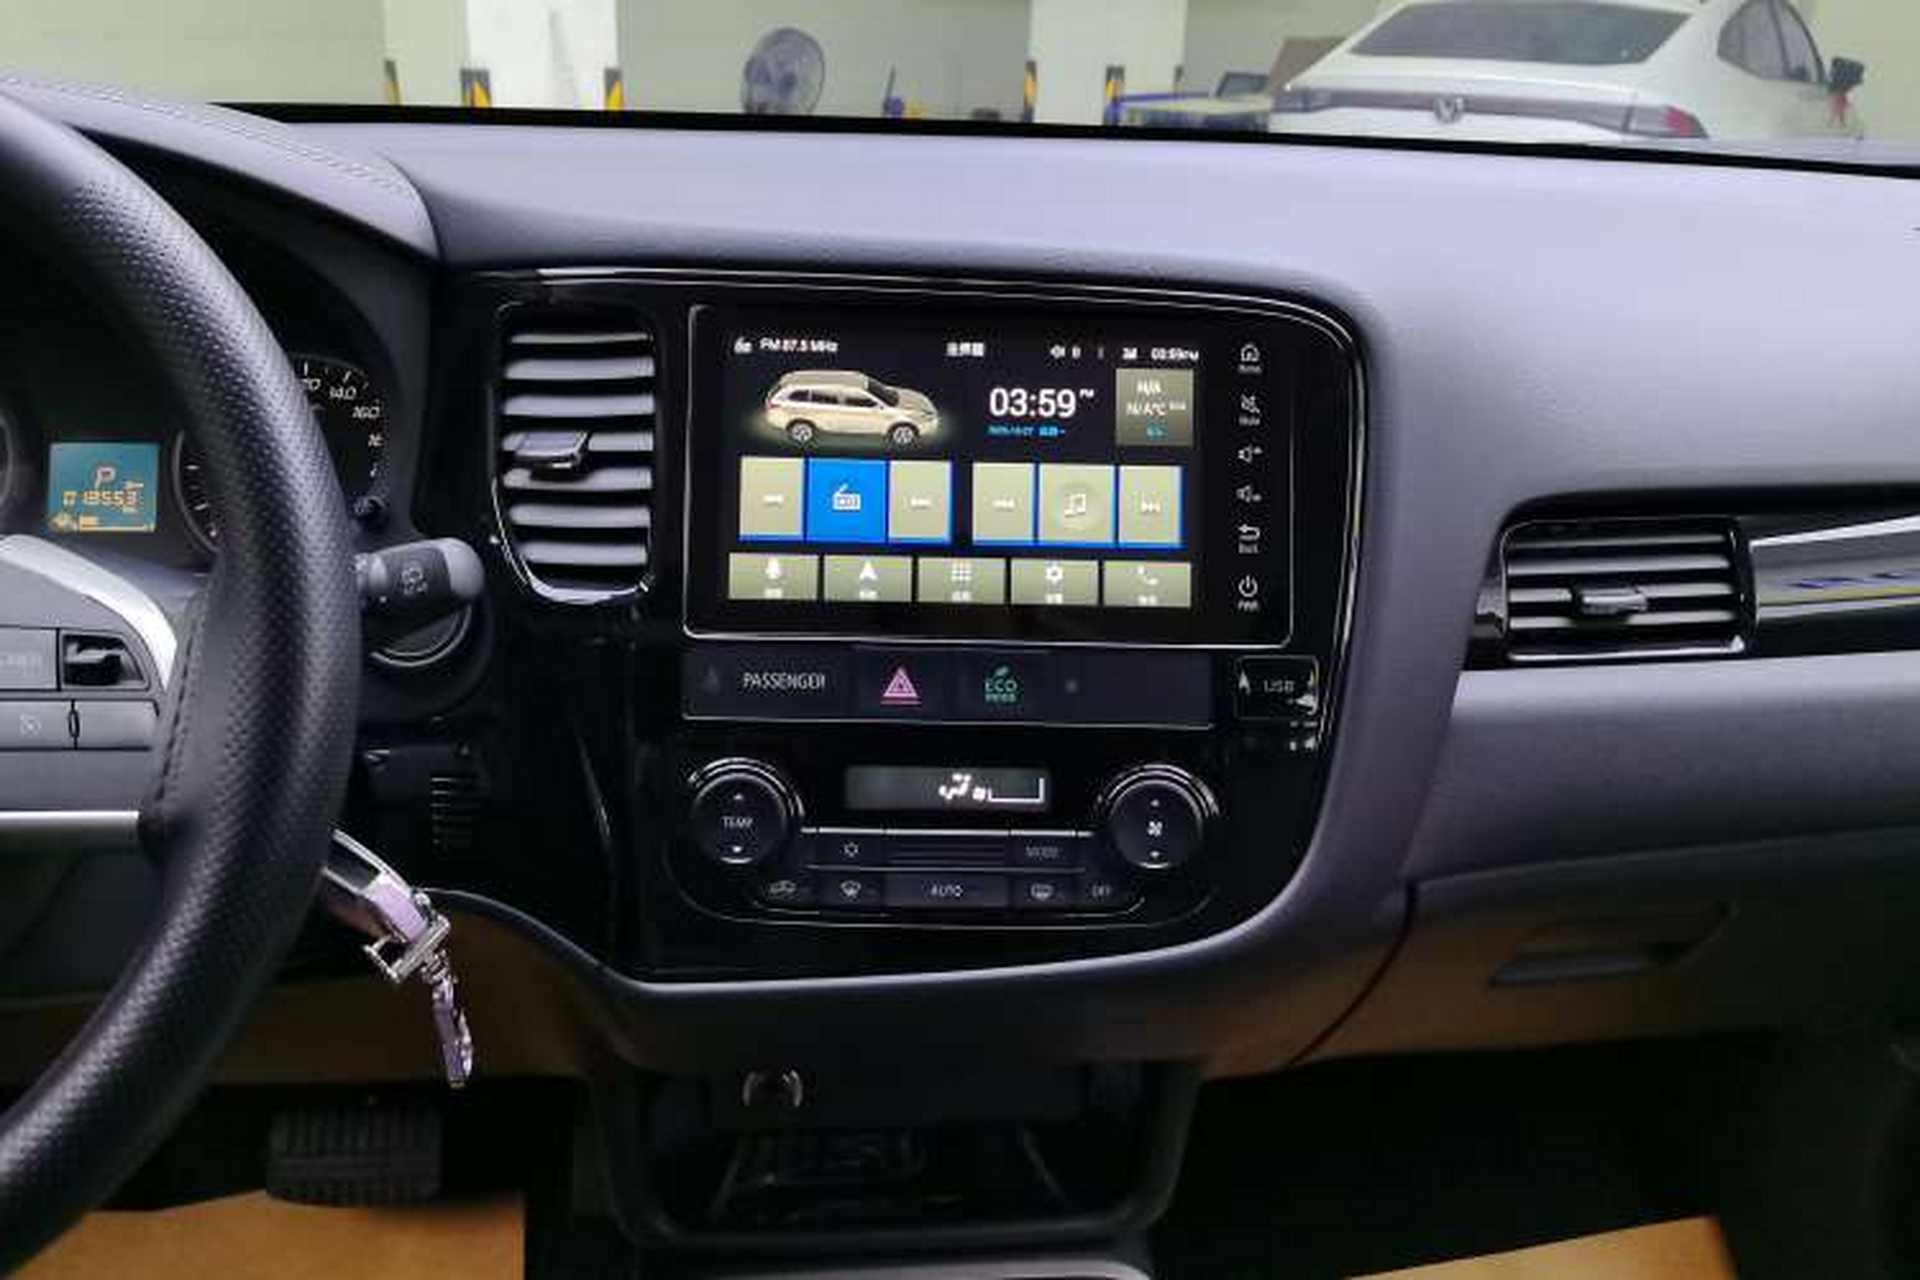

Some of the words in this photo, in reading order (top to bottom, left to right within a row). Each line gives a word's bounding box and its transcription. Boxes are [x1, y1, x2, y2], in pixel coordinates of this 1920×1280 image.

[990, 387, 1077, 418] 03:59
[94, 466, 117, 490] P
[743, 671, 826, 690] PASSENGER
[985, 678, 1018, 692] ECO
[721, 816, 753, 829] TEMP
[931, 884, 963, 897] AUTO
